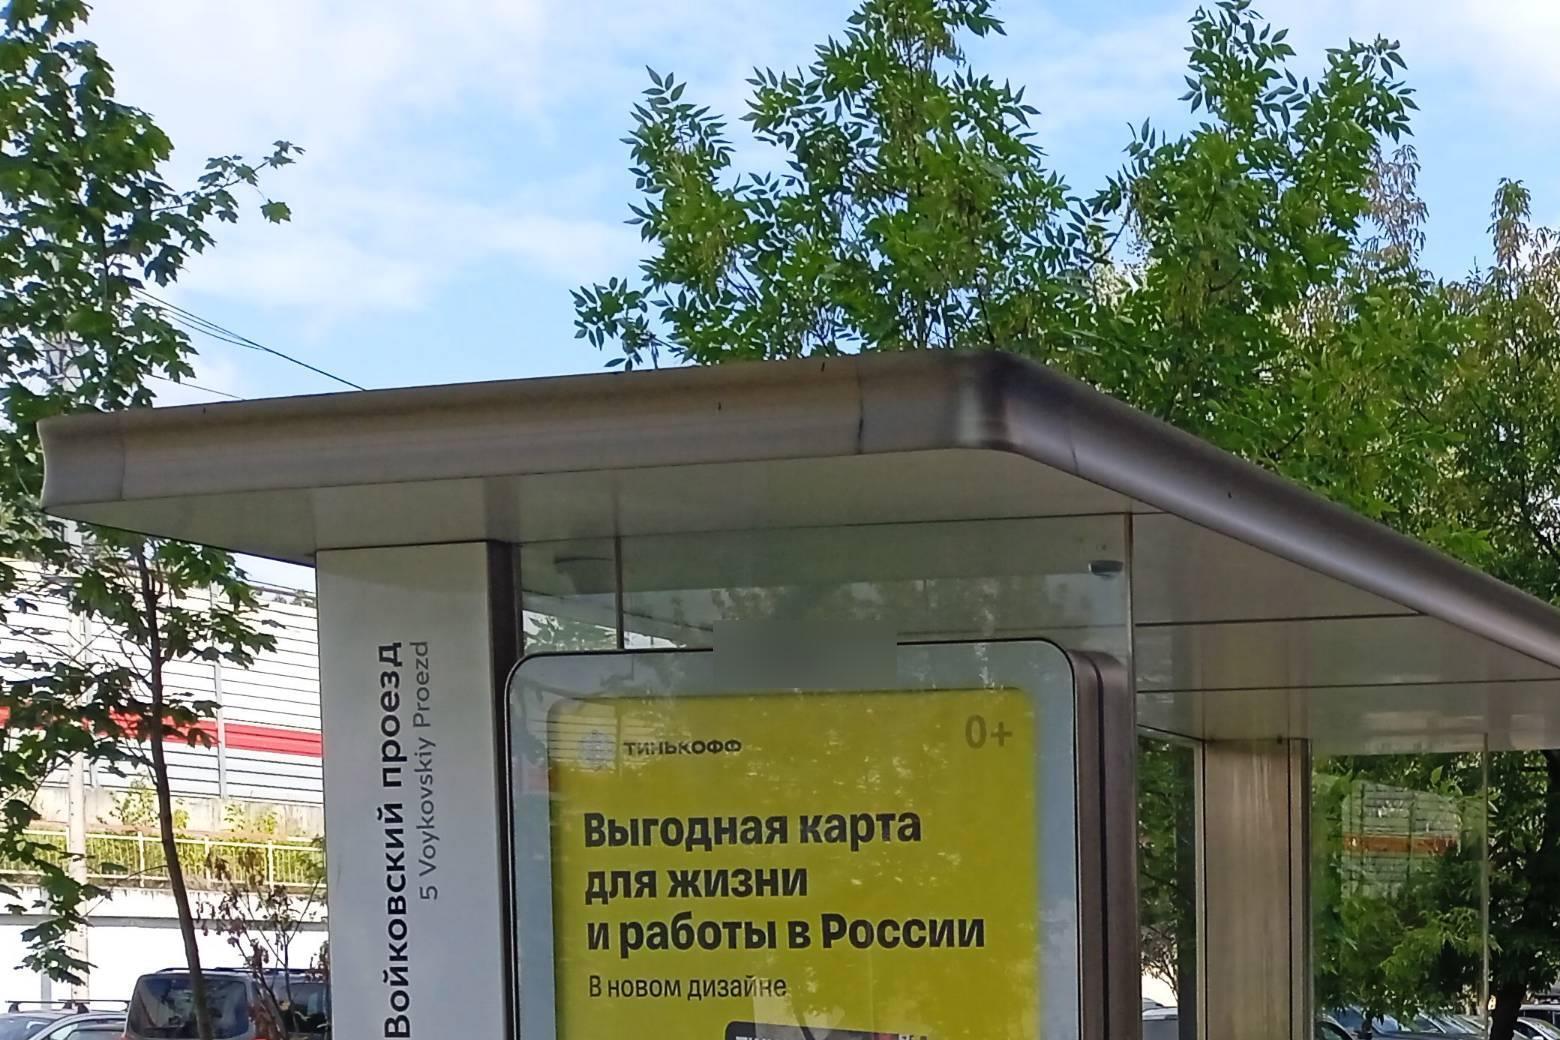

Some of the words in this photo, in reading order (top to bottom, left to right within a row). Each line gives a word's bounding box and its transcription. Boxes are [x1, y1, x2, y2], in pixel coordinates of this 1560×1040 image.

[409, 640, 431, 728] Proezd
[378, 642, 407, 787] проезд
[964, 714, 1013, 749] 0+
[623, 739, 742, 757] ТИНЬКОФФ
[414, 736, 440, 877] Voykovskiy
[583, 811, 789, 852] Выгодная
[799, 809, 922, 852] карта
[419, 885, 438, 900] 5
[584, 866, 657, 905] для
[667, 865, 808, 899] жизни
[377, 803, 411, 1038] Войковский
[587, 919, 609, 951] и
[620, 911, 776, 958] работы
[789, 917, 811, 948] в
[822, 912, 985, 950] России
[589, 975, 601, 997] В
[608, 977, 681, 998] новом
[687, 975, 787, 1000] дизайне
